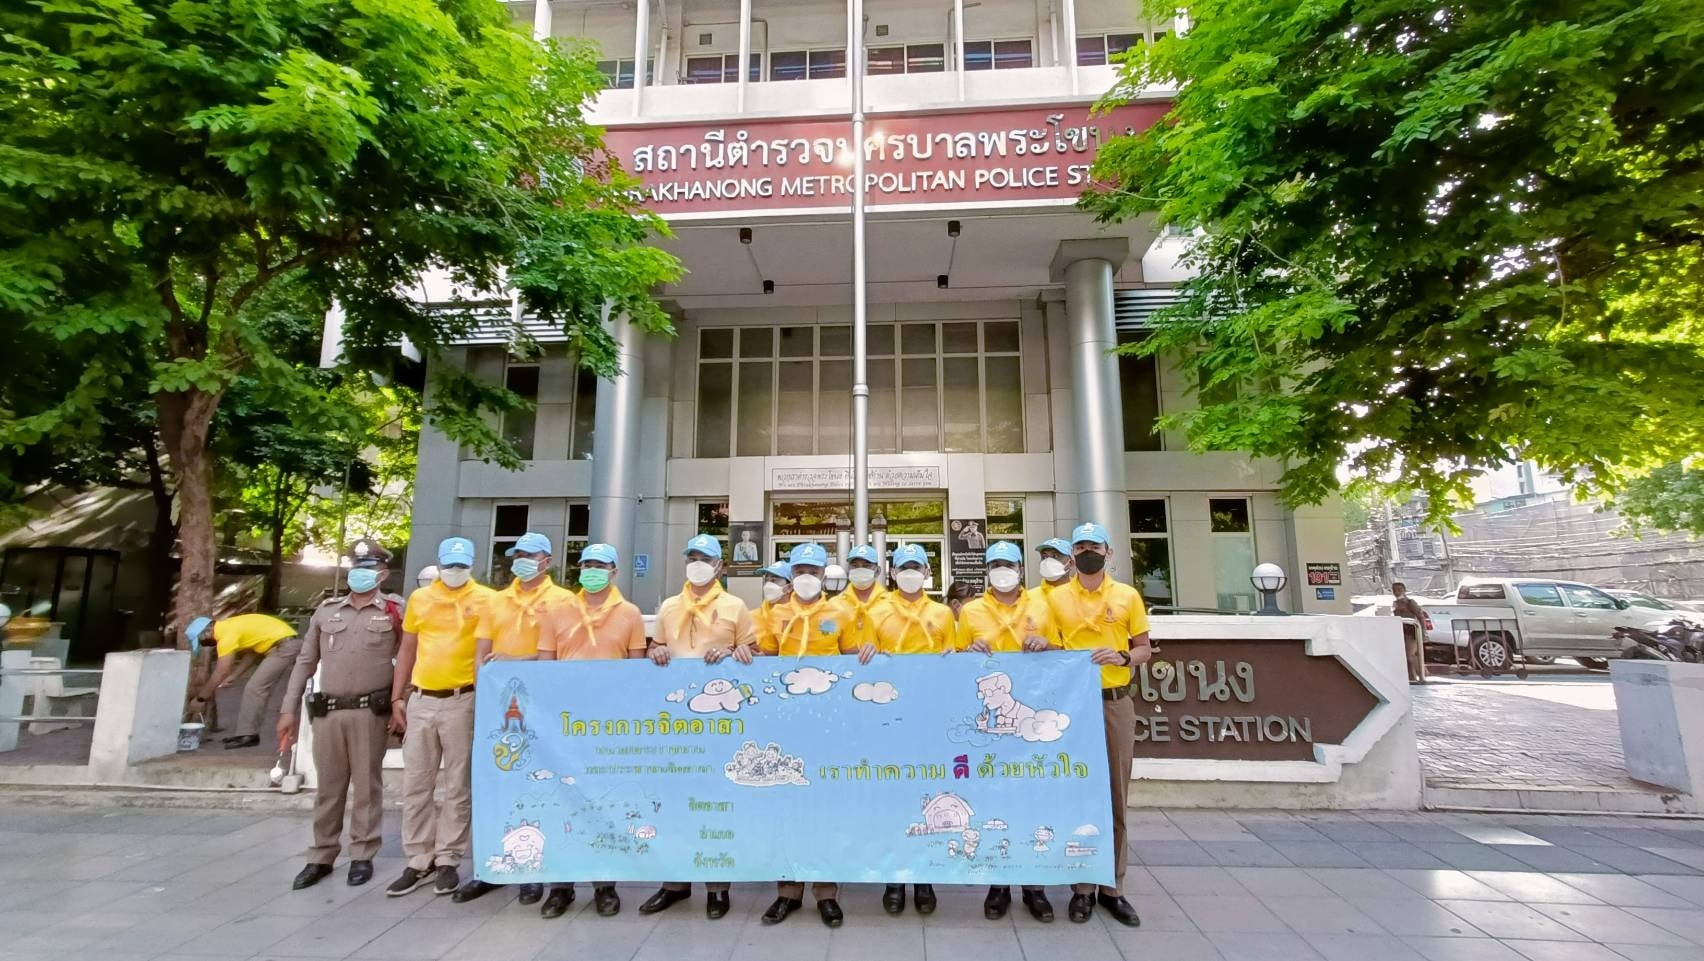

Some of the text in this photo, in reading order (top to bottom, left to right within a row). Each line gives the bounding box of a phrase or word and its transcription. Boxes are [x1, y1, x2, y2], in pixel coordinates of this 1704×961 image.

[632, 112, 1136, 173] สถานีตำรวจนครบาลพระโข
[975, 165, 1058, 189] POLICE
[1309, 571, 1329, 584] 191
[560, 711, 745, 736] โครงการจิตอาสา
[1179, 714, 1313, 743] STATION
[818, 752, 1088, 781] เราทำความ ดี ด้วยหัวใจ
